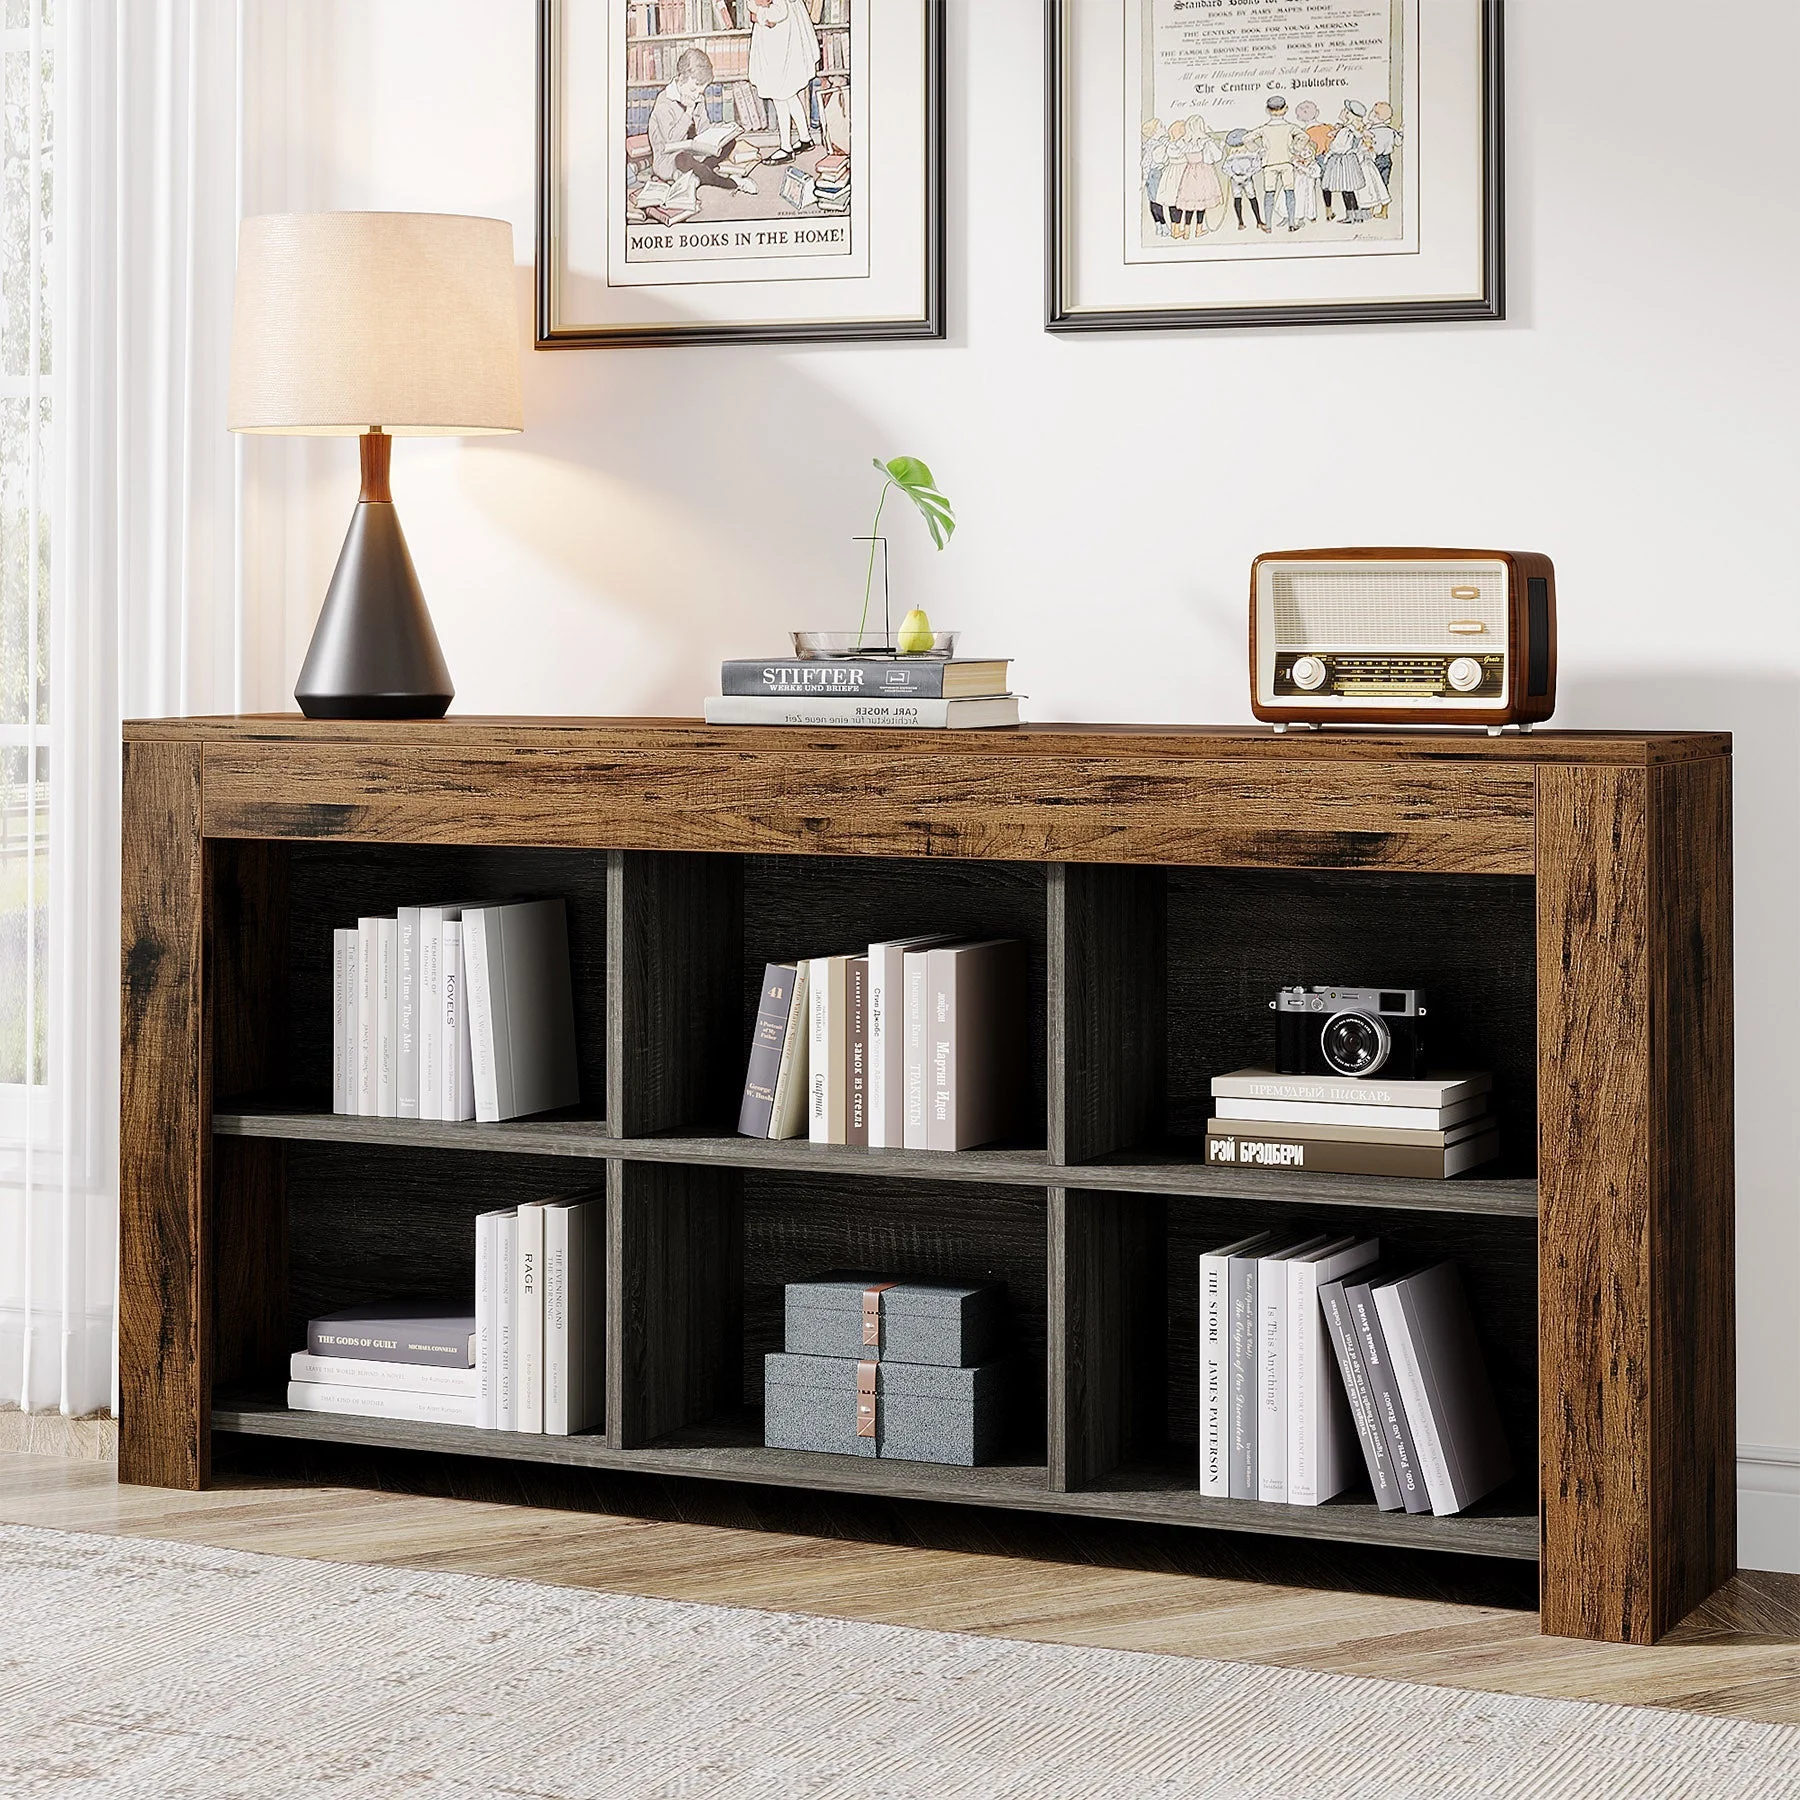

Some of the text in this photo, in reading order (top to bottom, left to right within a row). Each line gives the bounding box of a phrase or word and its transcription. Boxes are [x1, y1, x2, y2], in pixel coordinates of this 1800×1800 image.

[1177, 72, 1193, 81] All
[1194, 71, 1208, 80] are
[1210, 68, 1257, 79] Illustrated
[1258, 67, 1275, 76] and
[1277, 65, 1297, 74] Sold
[1300, 64, 1311, 73] at
[1193, 83, 1214, 93] The
[1220, 80, 1260, 92] Century
[1291, 74, 1348, 88] Publishers.
[1169, 99, 1188, 108] For
[1189, 98, 1209, 107] Sale
[631, 229, 844, 249] MORE BOOKS IN THE HOME!
[763, 668, 864, 685] STIFTER
[770, 684, 803, 692] WERKE
[804, 684, 824, 692] UND
[348, 945, 356, 1007] THE NOTEBOOK
[400, 924, 412, 1053] The Last Time They Met
[431, 984, 438, 995] OF
[446, 975, 456, 1028] KOVELS'
[768, 986, 783, 999] 41
[783, 977, 804, 1059] Puerto Vallarta Squeeze
[910, 971, 922, 1048] Иммануил Кант
[746, 1090, 773, 1101] W. Bush
[750, 1083, 772, 1094] George
[910, 1064, 921, 1126] ТРАКТАТЫ
[934, 1041, 950, 1121] Мартин Иден
[1248, 1084, 1391, 1102] ПРЕМУДРЫЙ ПИСКАРЬ
[812, 1074, 825, 1120] Спартак
[1210, 1136, 1304, 1166] РЭЙ БРЭДБЕРИ
[524, 1254, 532, 1294] RAGE
[317, 1334, 397, 1350] THE GODS OF GUILT
[407, 1343, 457, 1354] MICHAEL CONNELLY
[1298, 1342, 1304, 1352] OF
[1266, 1305, 1278, 1412] Is This Anything?
[1341, 1358, 1354, 1387] Literary
[1208, 1270, 1218, 1484] THE STORE JAMES PATTERSON
[1234, 1300, 1244, 1450] The Origins of Our Discontents
[1329, 1298, 1388, 1489] Terry Cochran
[1344, 1333, 1384, 1458] Figures of Thought in the Age of Print
[1349, 1387, 1357, 1400] the
[1298, 1414, 1304, 1424] OF
[1354, 1407, 1367, 1436] Twilight
